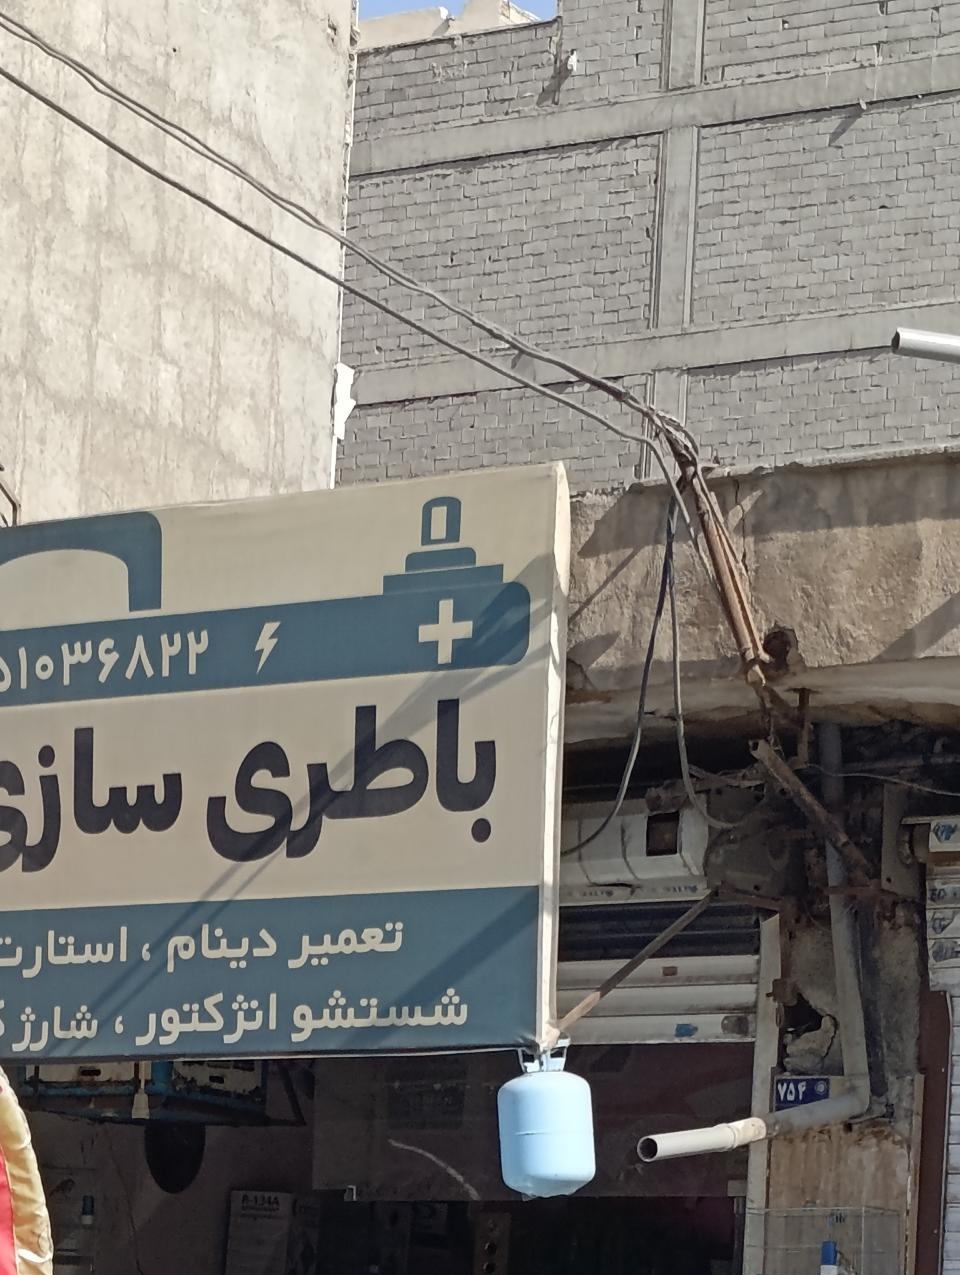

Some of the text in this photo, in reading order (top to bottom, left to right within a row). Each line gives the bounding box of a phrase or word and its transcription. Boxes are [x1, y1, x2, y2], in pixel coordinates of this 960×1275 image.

[205, 698, 497, 863] باطری
[166, 923, 278, 973] دینام
[288, 920, 405, 968] تعمیر
[11, 1003, 100, 1053] شارژ
[135, 992, 277, 1046] انژکتور
[290, 986, 469, 1042] شستشو
[777, 1080, 807, 1102] ۷۵۴
